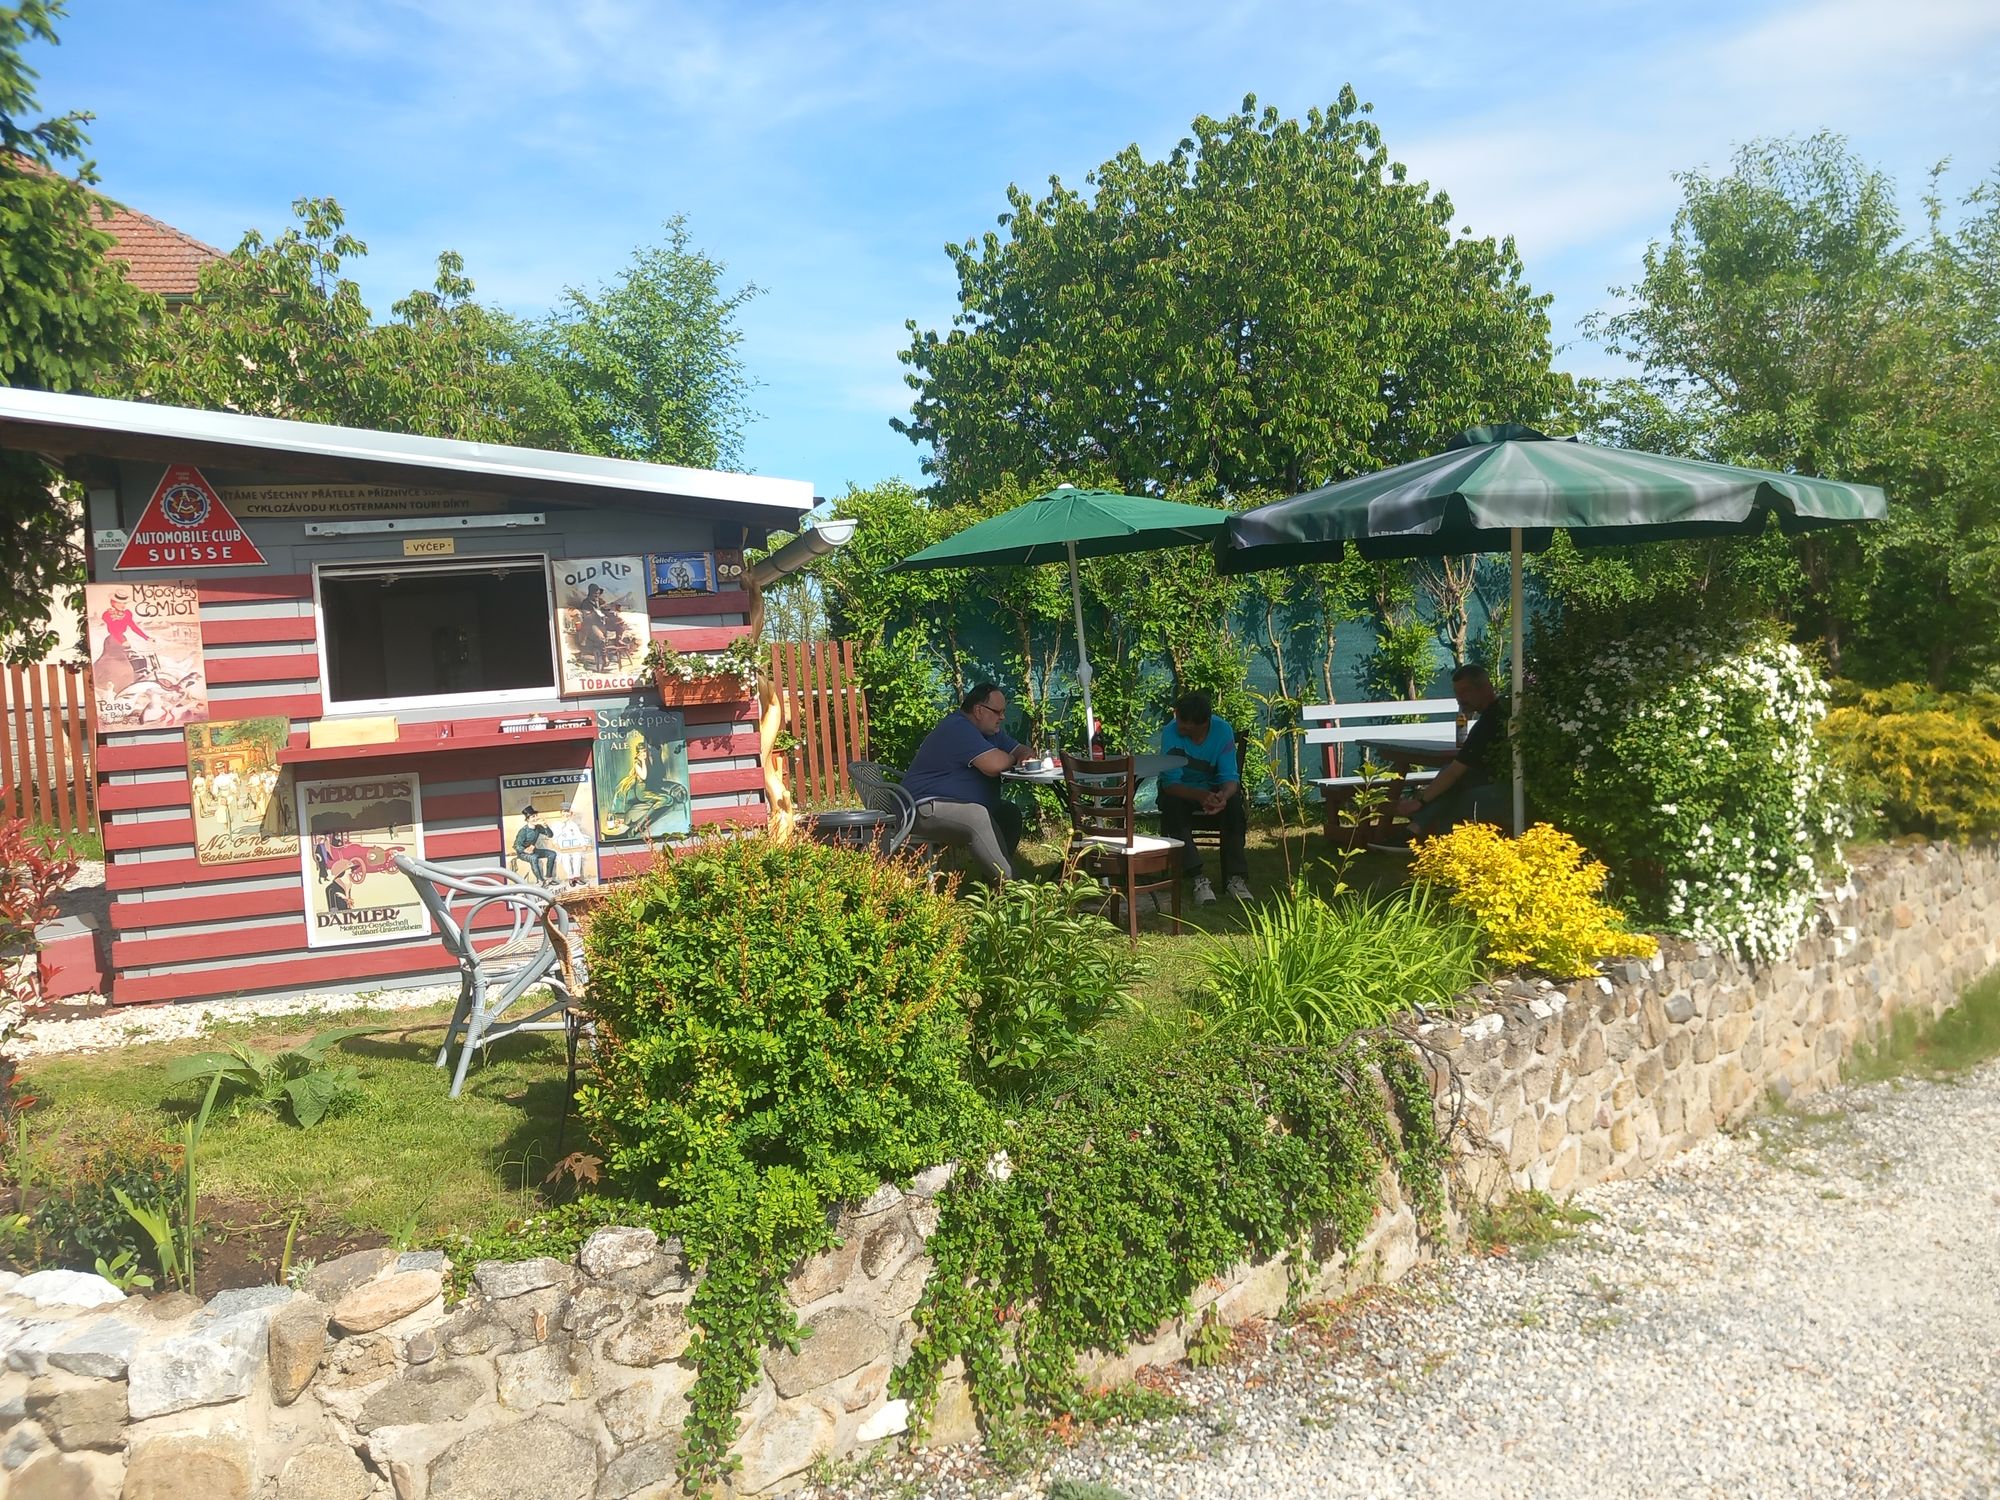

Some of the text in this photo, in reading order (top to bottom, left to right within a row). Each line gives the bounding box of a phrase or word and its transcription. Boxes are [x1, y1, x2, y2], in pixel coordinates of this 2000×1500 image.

[261, 489, 308, 500] VŠECHNY
[312, 488, 355, 499] PŘÁTELE
[358, 490, 365, 498] A
[247, 502, 327, 513] CYKLOZÁVODU
[329, 500, 407, 513] KLOSTERMANN
[413, 542, 445, 551] VÝČEP
[149, 546, 232, 562] SUISSE
[564, 560, 632, 586] OLD RIP
[134, 599, 197, 617] COMIOT
[579, 677, 634, 690] TOBACCO
[610, 742, 630, 751] ALE
[307, 781, 412, 805] MERCEDES
[201, 851, 233, 862] Cakes
[252, 843, 298, 858] Biscuits
